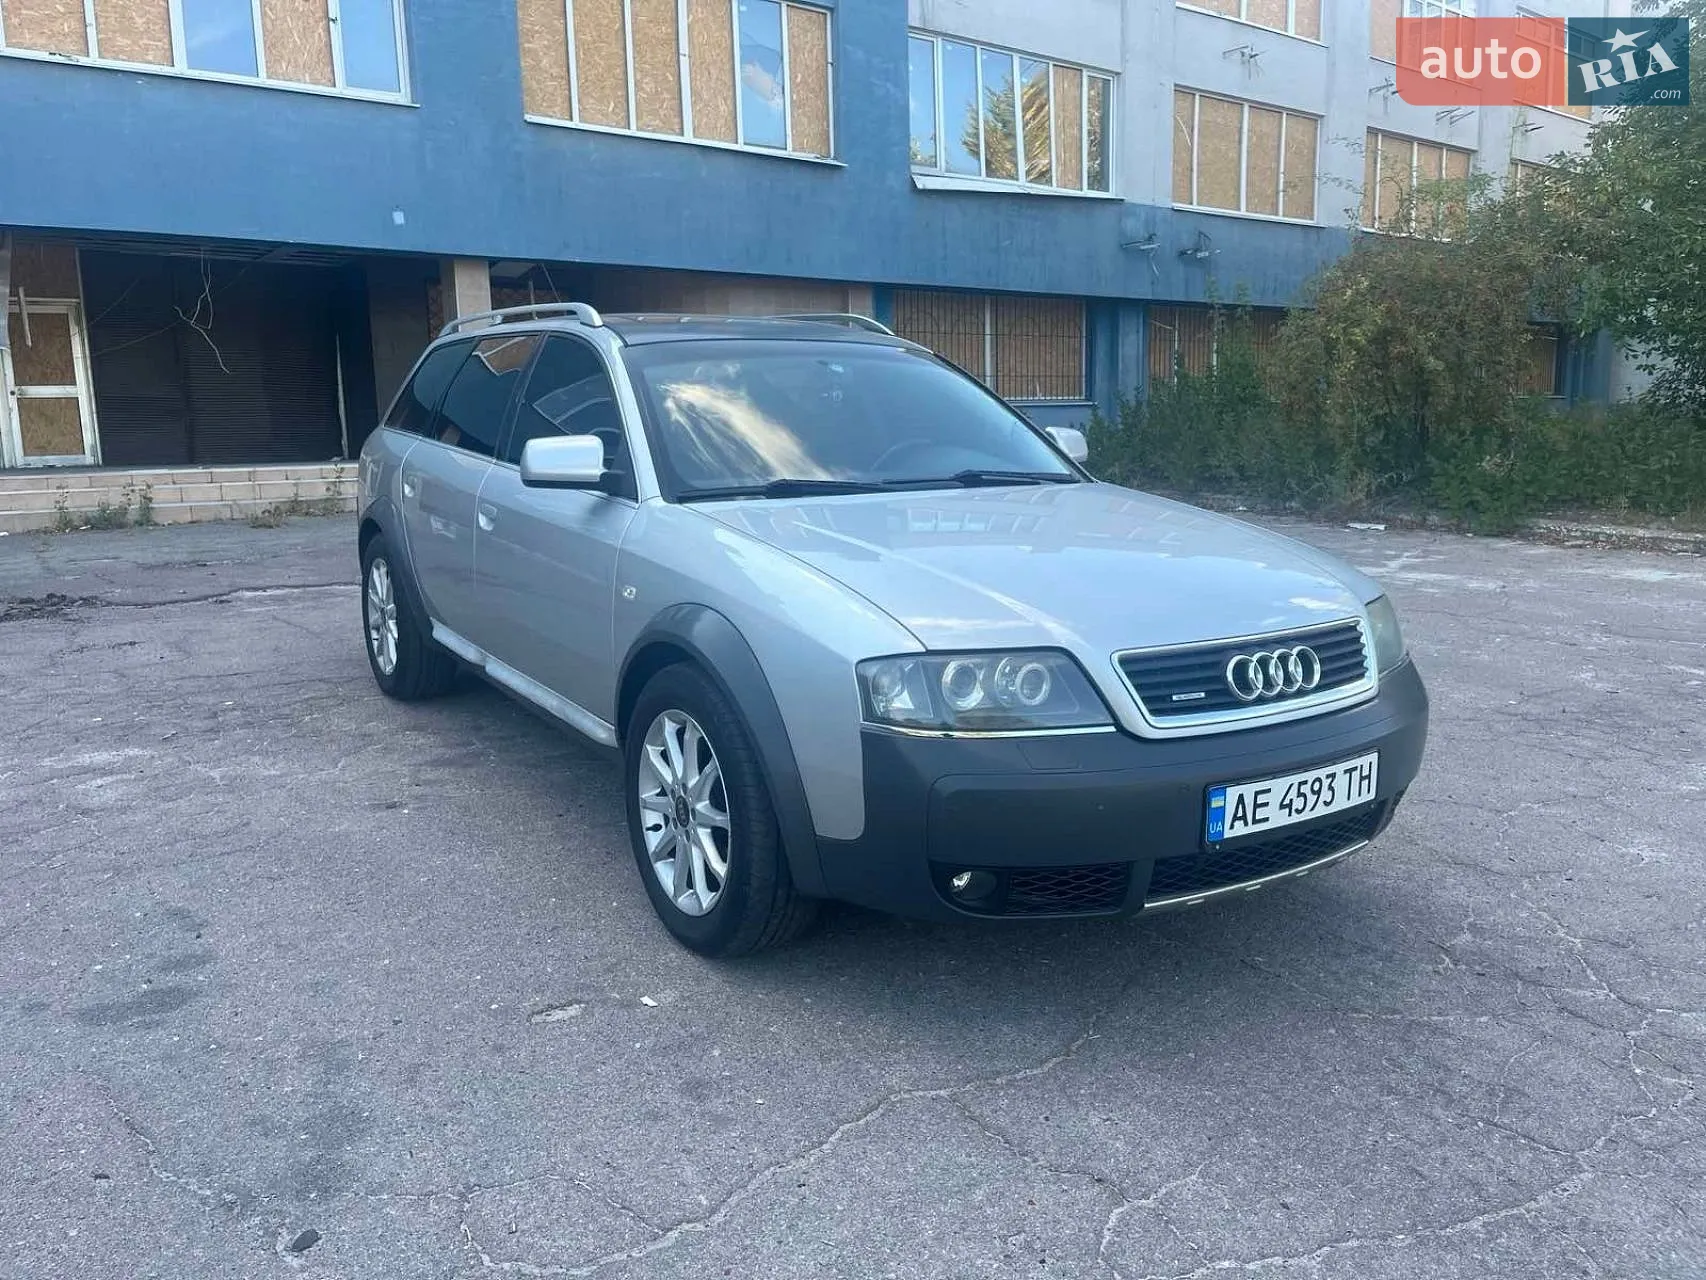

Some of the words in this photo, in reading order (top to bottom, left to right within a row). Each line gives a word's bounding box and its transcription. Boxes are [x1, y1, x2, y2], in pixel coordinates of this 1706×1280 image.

[1229, 788, 1272, 830] AE
[1279, 772, 1337, 817] 4593
[1343, 761, 1372, 801] TH
[1209, 821, 1223, 834] UA
